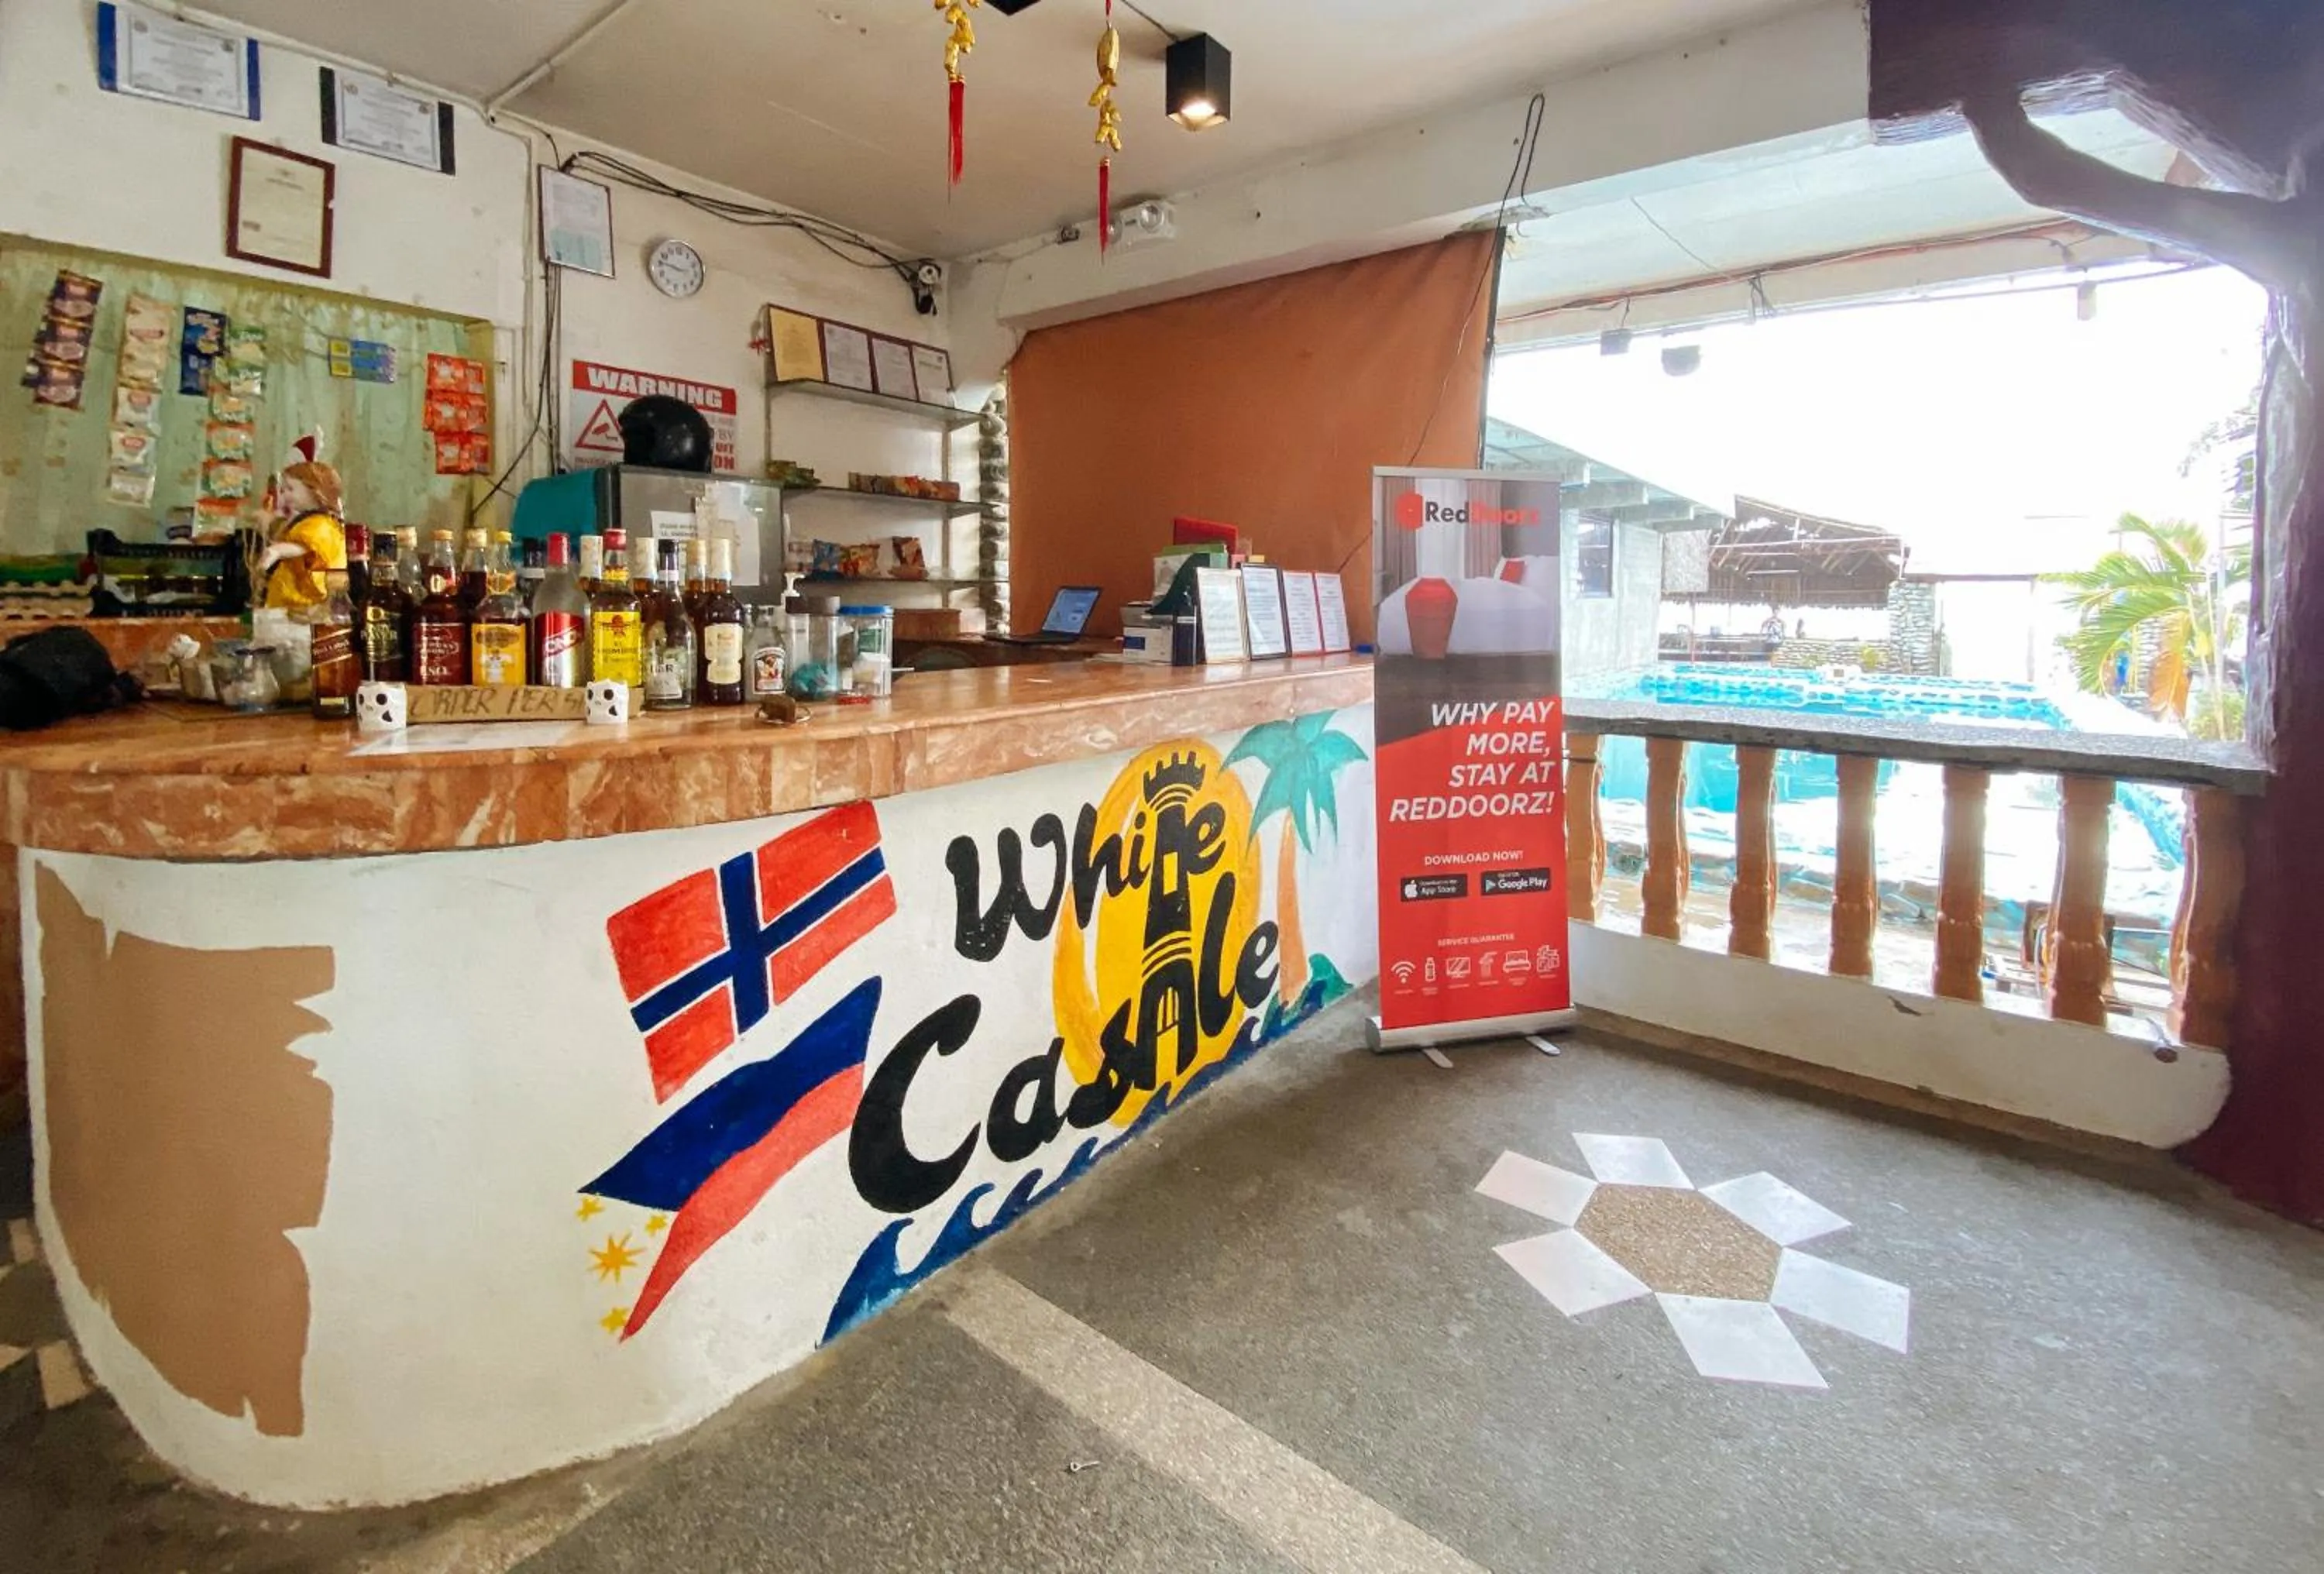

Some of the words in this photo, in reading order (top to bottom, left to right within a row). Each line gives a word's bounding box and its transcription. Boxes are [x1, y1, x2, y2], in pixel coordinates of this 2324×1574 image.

[587, 366, 722, 409] WARNING
[1432, 701, 1498, 727] WHY
[1502, 701, 1556, 725] PAY
[1466, 730, 1552, 757] MORE,
[1448, 762, 1515, 788] STAY
[1518, 761, 1556, 784] AT
[1389, 791, 1556, 823] REDDOORZ!
[1424, 853, 1490, 866] DOWNLOAD
[1493, 850, 1524, 861] NOW!
[1421, 887, 1437, 895] App
[1497, 878, 1528, 890] Google
[1528, 876, 1548, 888] Play
